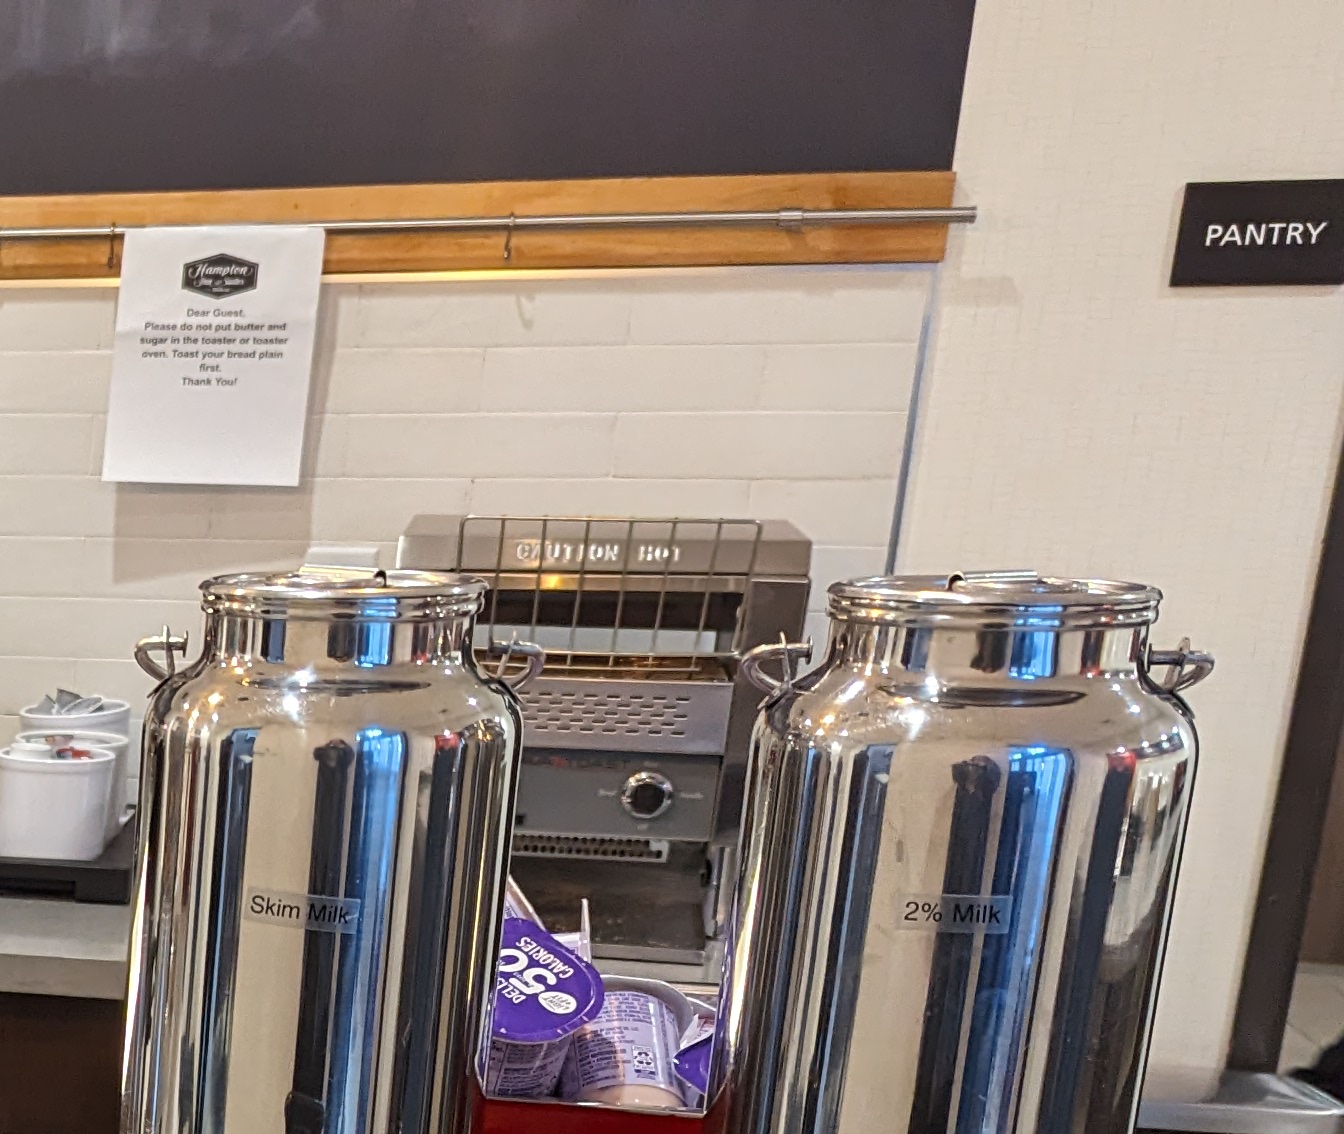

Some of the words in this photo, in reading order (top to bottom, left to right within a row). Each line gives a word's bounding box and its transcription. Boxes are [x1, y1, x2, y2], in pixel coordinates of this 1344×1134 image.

[1204, 221, 1328, 247] PANTRY
[188, 263, 253, 278] Hampton
[186, 308, 210, 318] Dear
[144, 322, 177, 332] Please
[179, 322, 193, 332] do
[195, 322, 212, 332] not
[214, 323, 231, 334] put
[234, 322, 264, 332] butter
[267, 322, 287, 332] and
[139, 337, 168, 347] sugar
[170, 336, 180, 345] in
[182, 336, 198, 345] the
[201, 337, 236, 345] toaster
[252, 337, 289, 346] toaster
[172, 350, 199, 359] Toast
[201, 351, 225, 361] your
[227, 350, 256, 359] bread
[258, 350, 283, 361] plain
[199, 363, 222, 373] first.
[181, 377, 212, 387] Thank
[215, 377, 238, 387] You!
[516, 543, 620, 561] CAUTION
[639, 545, 681, 562] HOT
[250, 894, 301, 920] Skim
[307, 903, 350, 924] Milk
[904, 901, 943, 922] 2%
[952, 903, 1002, 924] Milk
[515, 936, 574, 979] CALORIES
